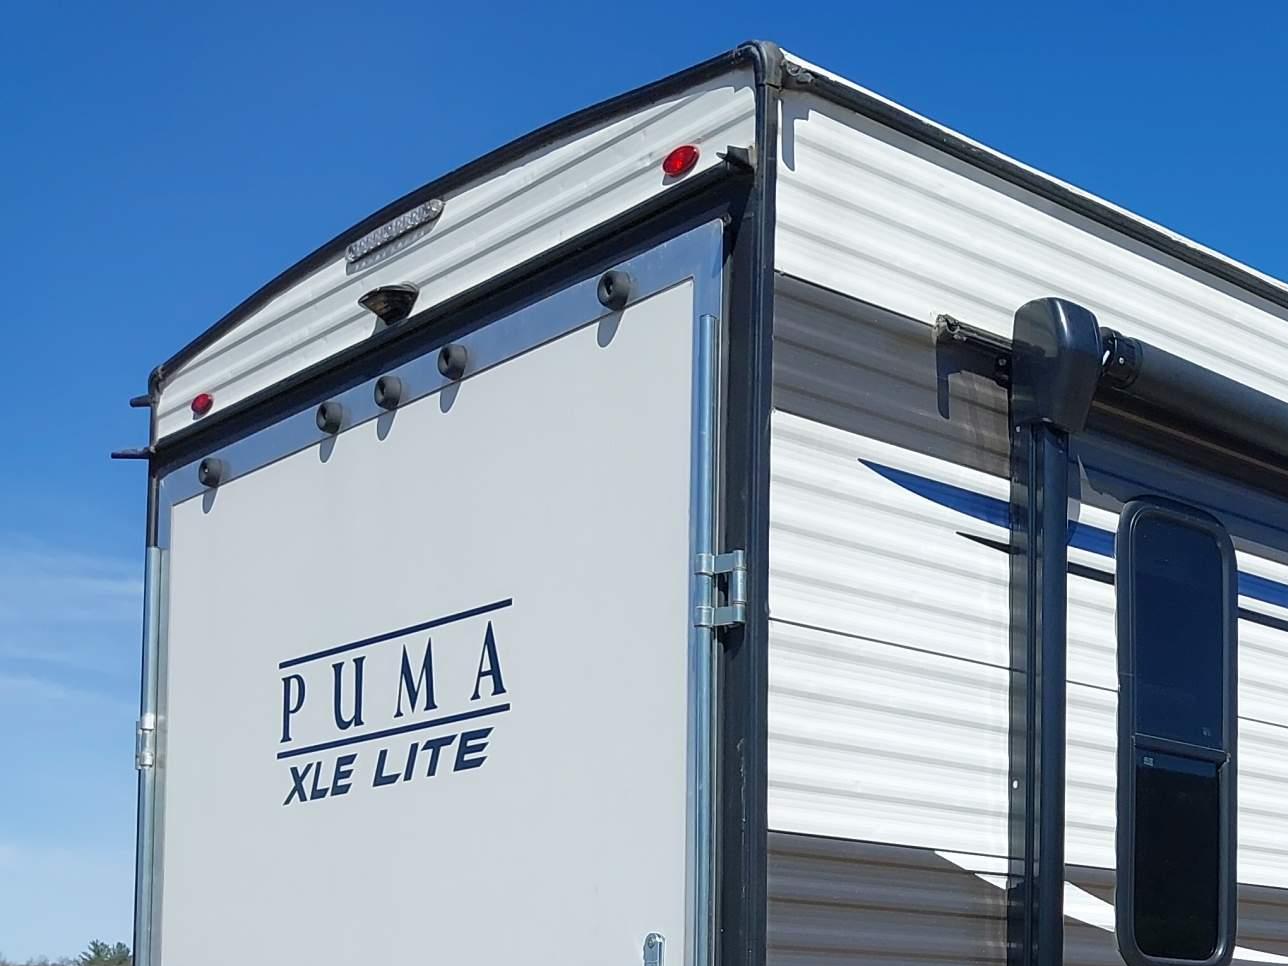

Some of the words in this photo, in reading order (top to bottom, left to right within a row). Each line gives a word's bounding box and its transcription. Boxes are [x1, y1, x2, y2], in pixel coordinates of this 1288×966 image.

[279, 619, 508, 744] PUMA
[282, 752, 358, 806] XLE
[371, 726, 495, 788] LITE
